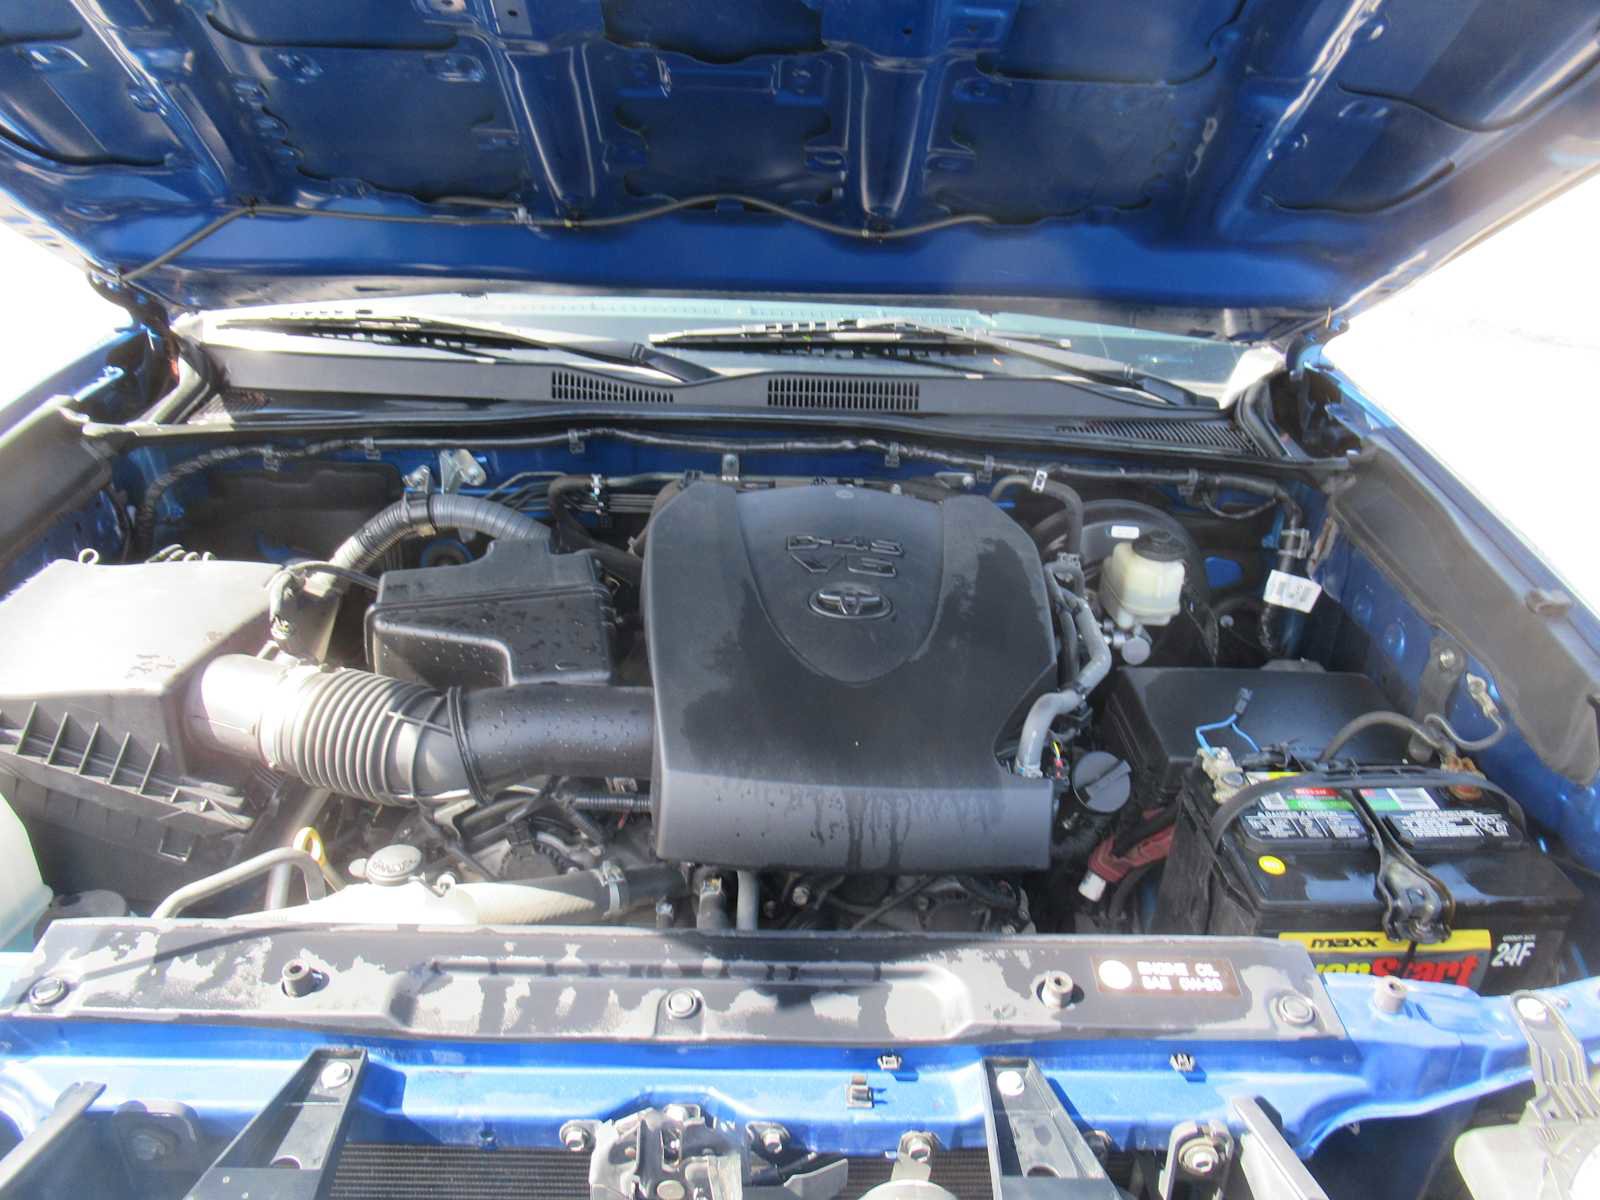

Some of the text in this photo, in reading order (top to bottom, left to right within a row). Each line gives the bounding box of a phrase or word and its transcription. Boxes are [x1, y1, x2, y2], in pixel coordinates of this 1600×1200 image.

[791, 554, 897, 578] V6
[1311, 937, 1379, 948] maxx
[1490, 942, 1536, 967] 24F
